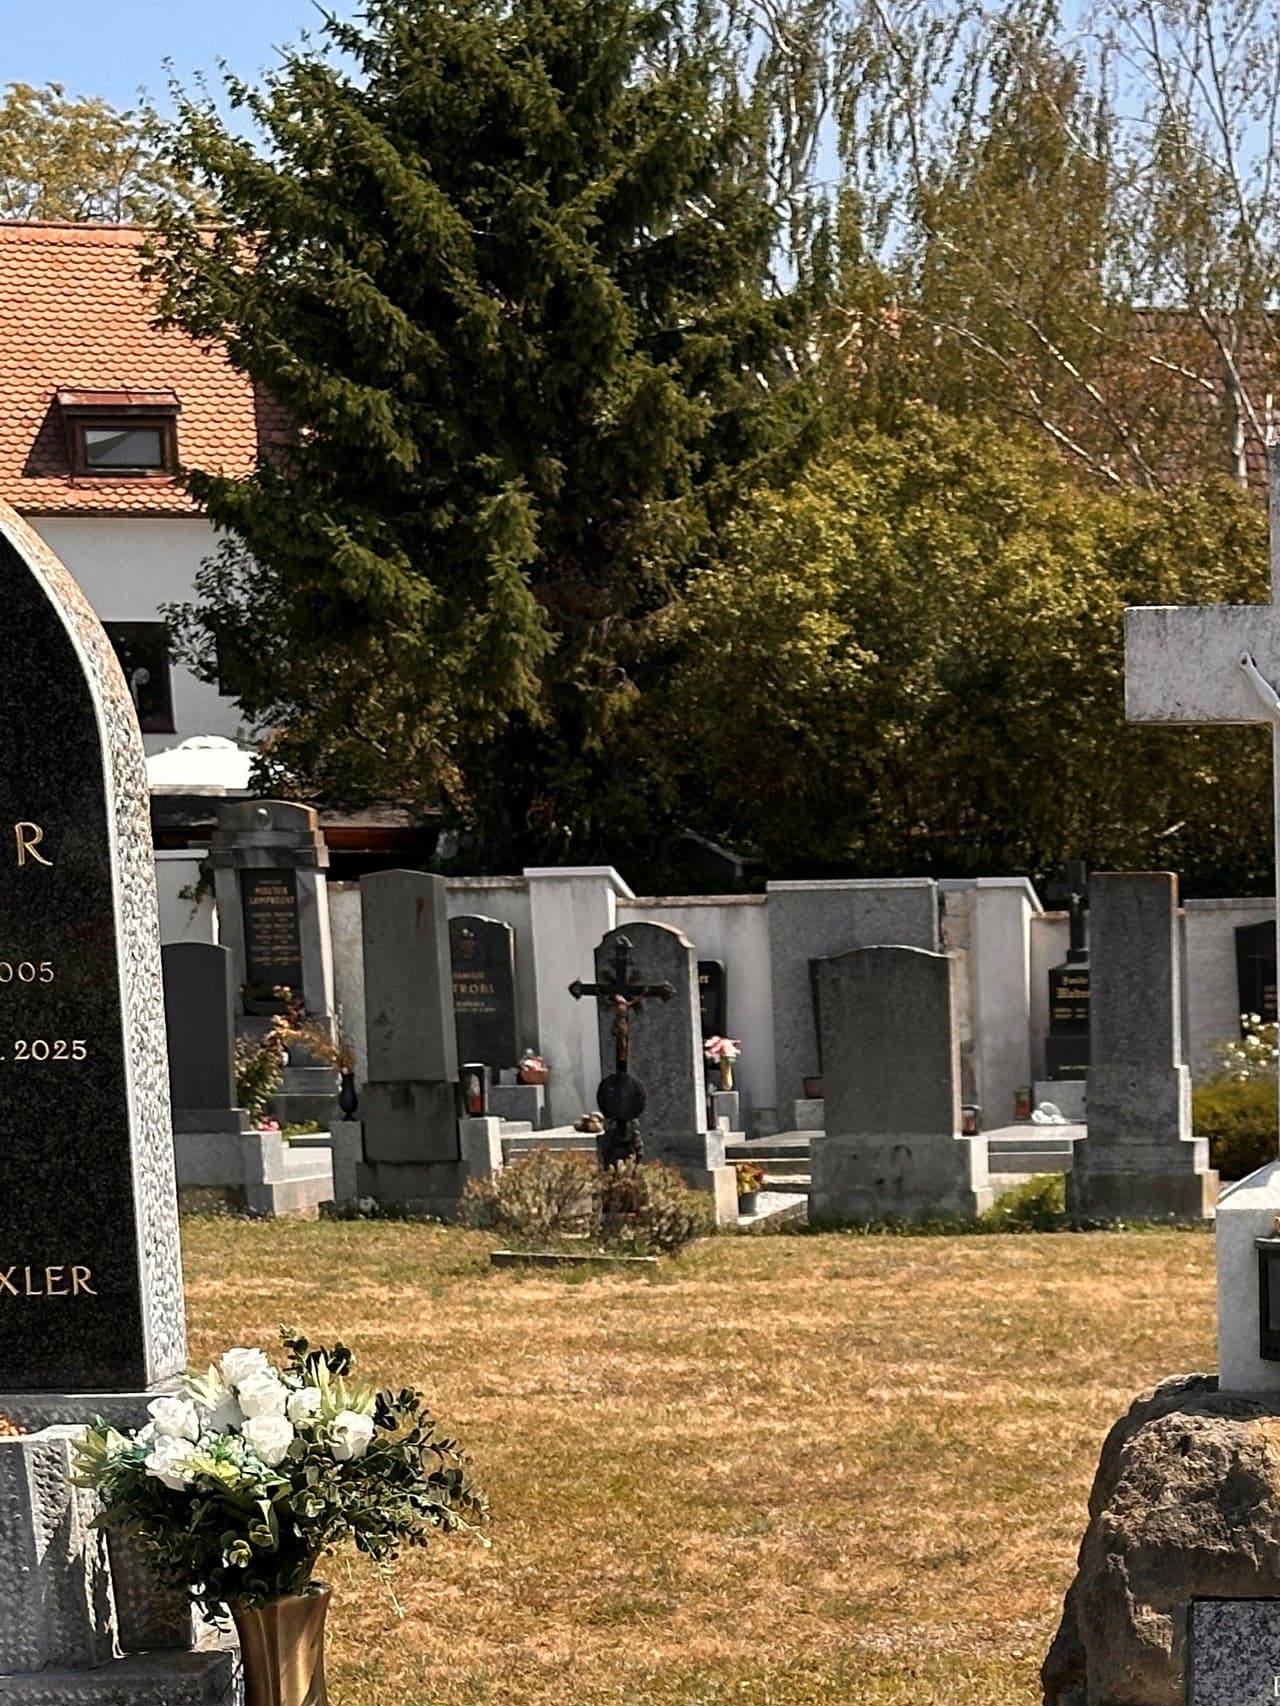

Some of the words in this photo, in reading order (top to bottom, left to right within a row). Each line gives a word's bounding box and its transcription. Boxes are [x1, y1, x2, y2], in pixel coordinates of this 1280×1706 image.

[14, 821, 54, 867] R
[0, 961, 55, 983] 005
[14, 1039, 88, 1061] 2025
[0, 1265, 98, 1296] XLER
